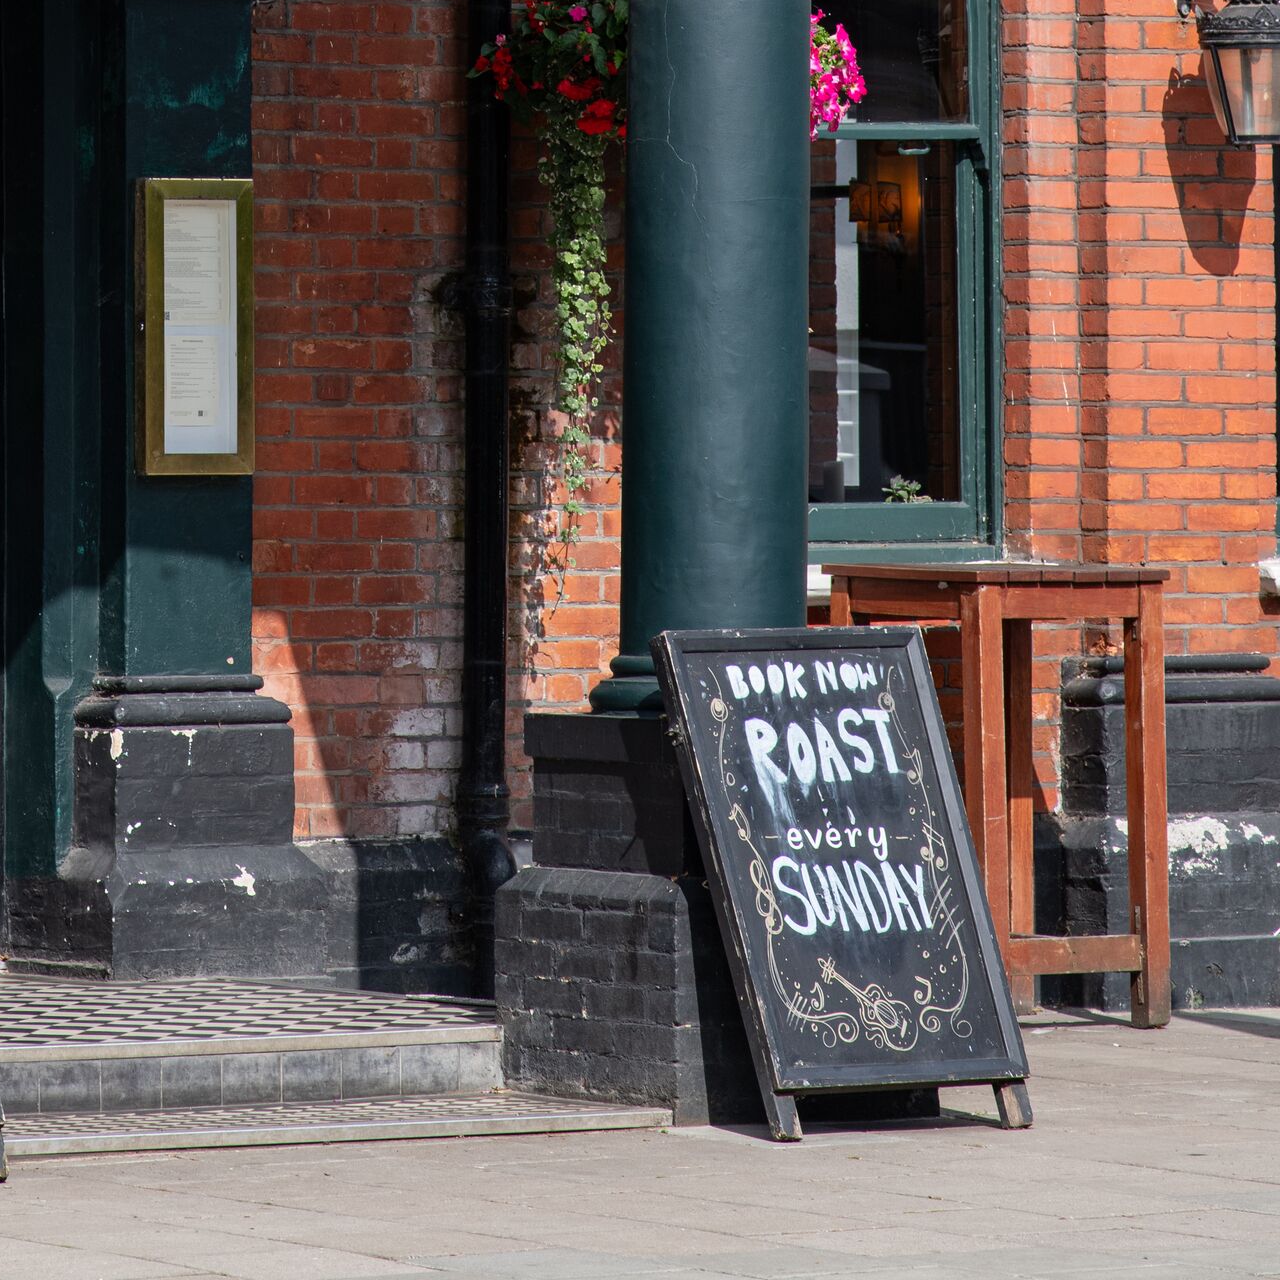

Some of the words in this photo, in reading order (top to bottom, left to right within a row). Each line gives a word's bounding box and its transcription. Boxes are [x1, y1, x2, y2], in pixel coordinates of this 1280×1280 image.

[726, 661, 808, 700] BOOK
[814, 660, 878, 695] NOW
[744, 707, 899, 786] ROAST
[786, 825, 889, 868] every
[772, 854, 933, 937] SUNDAY
